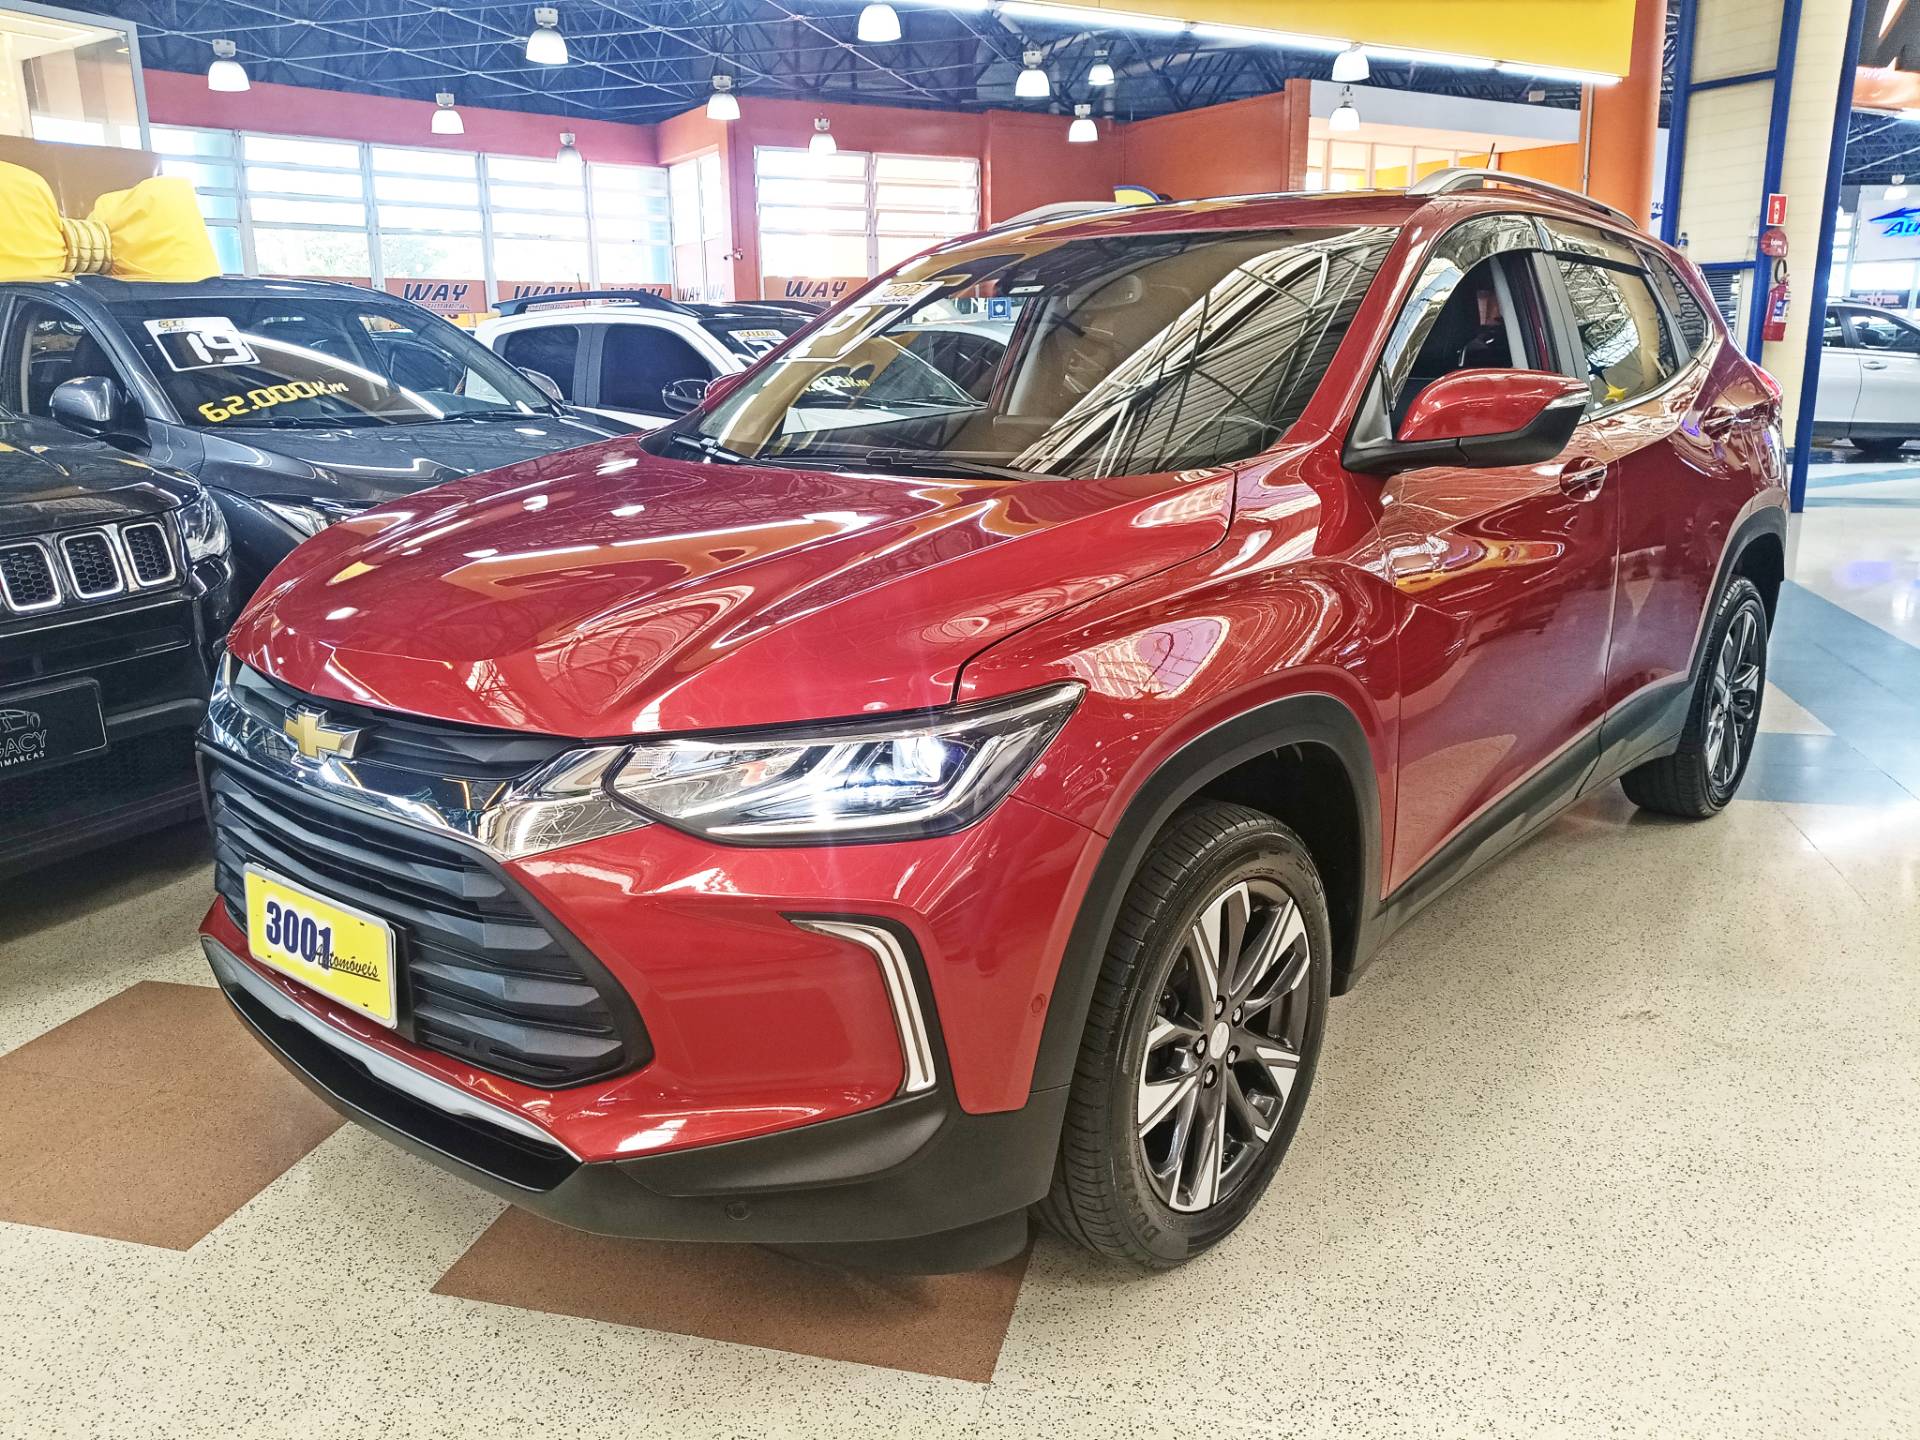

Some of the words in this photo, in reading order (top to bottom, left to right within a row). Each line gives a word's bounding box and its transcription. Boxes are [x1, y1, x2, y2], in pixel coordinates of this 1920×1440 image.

[403, 283, 469, 302] WAY
[784, 279, 848, 299] WAY
[186, 331, 250, 364] 19
[0, 728, 47, 758] ACY
[265, 899, 332, 971] 3001
